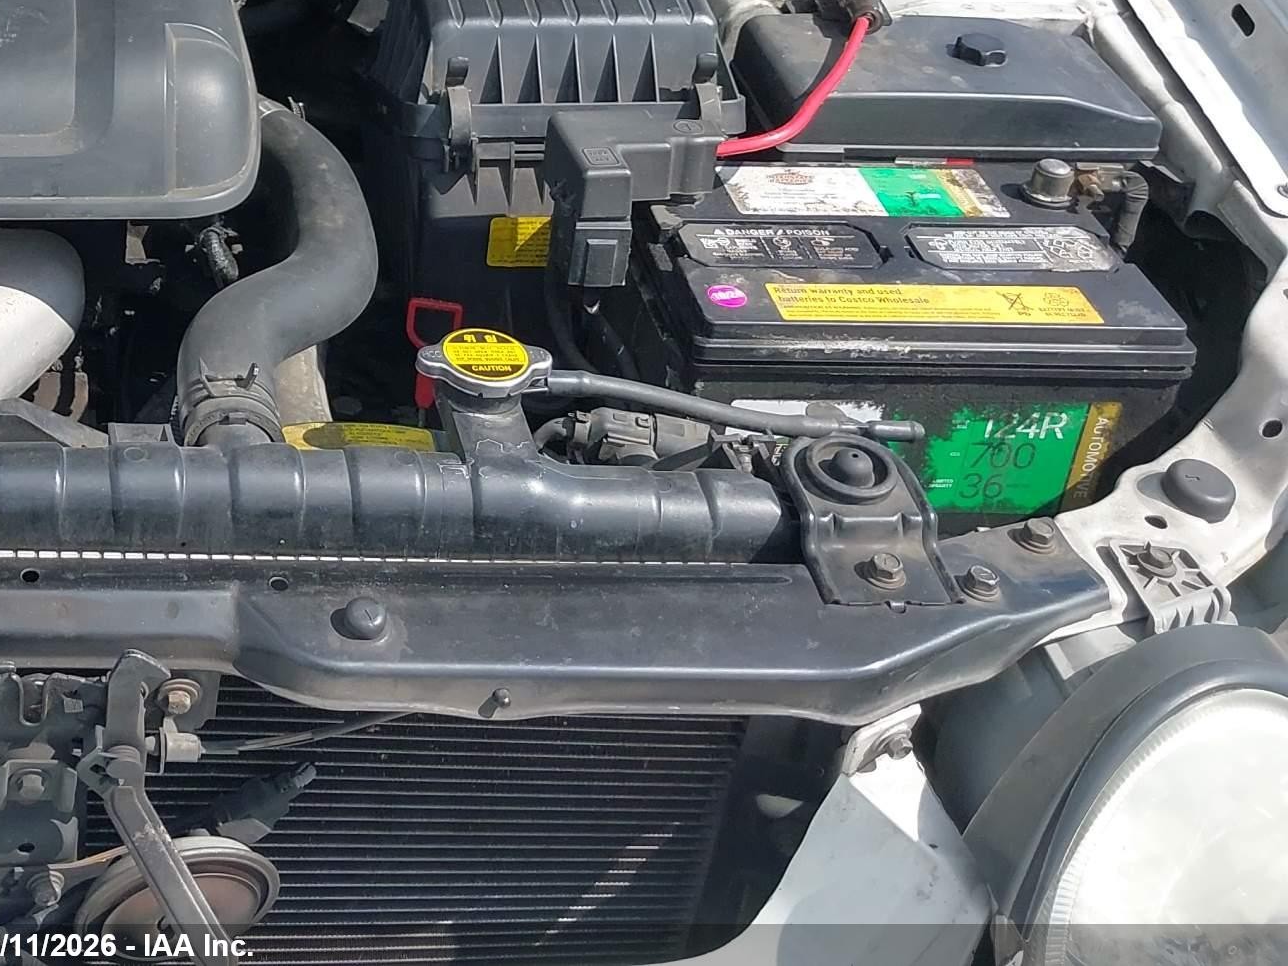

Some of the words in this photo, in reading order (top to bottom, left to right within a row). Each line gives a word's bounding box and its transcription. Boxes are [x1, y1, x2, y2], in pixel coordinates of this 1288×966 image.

[725, 228, 774, 236] DANGER
[809, 287, 853, 296] warranty
[875, 296, 930, 304] Wholesale
[471, 364, 512, 372] CAUTION
[969, 442, 1036, 469] 700
[1073, 417, 1111, 499] AUTOMOTIVE
[959, 473, 1004, 500] 36
